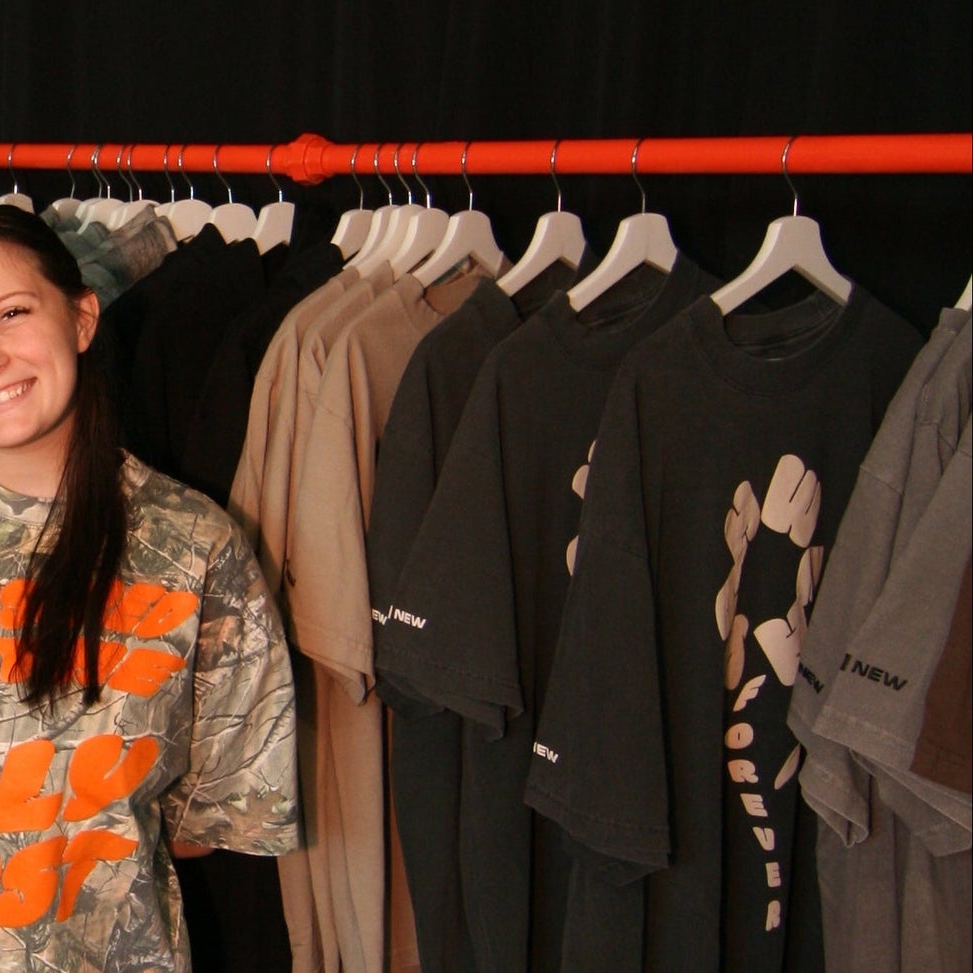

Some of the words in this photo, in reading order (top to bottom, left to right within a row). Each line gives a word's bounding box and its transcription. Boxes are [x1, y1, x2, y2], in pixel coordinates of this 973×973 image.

[371, 608, 388, 626] EW
[394, 608, 427, 629] NEW
[851, 660, 908, 691] NEW
[724, 675, 781, 931] FOREVER
